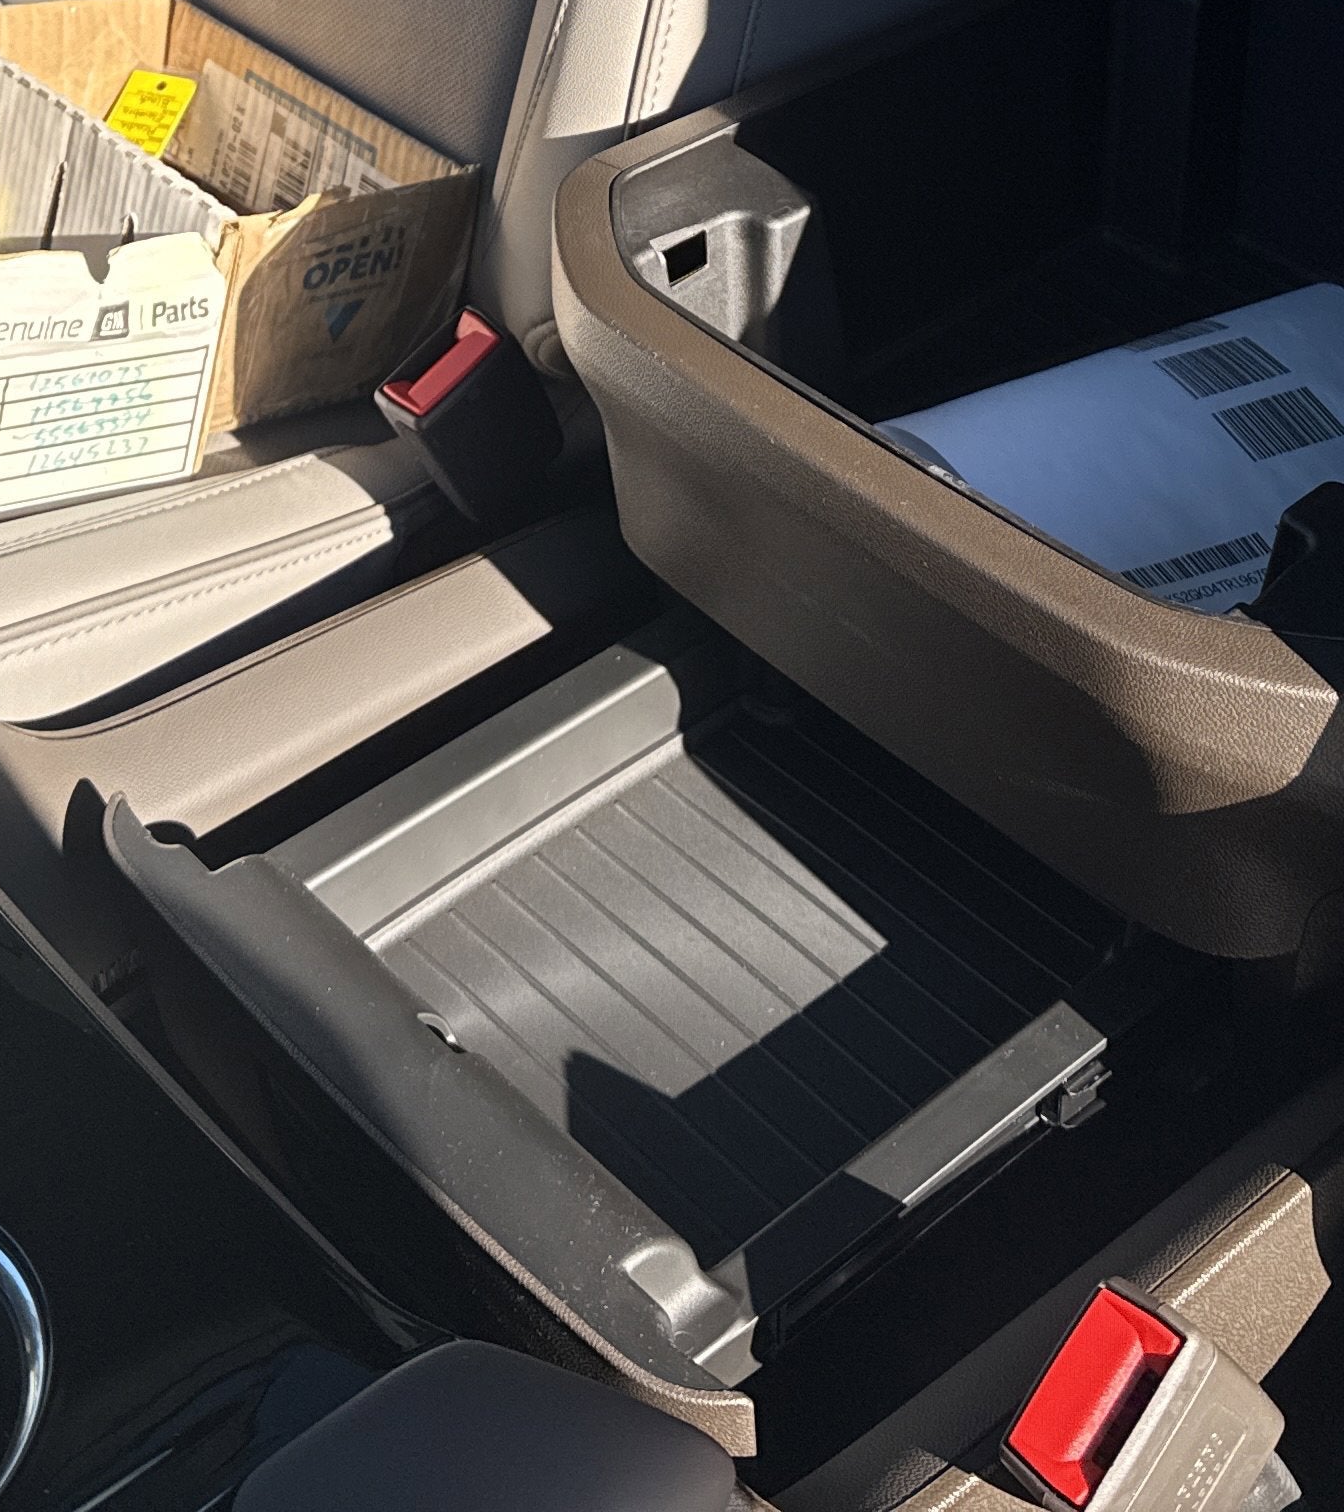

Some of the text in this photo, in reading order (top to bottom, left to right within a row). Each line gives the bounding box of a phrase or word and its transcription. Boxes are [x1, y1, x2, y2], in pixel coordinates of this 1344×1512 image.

[303, 242, 405, 290] OPEN!
[99, 309, 128, 330] GM
[151, 296, 210, 327] Parts
